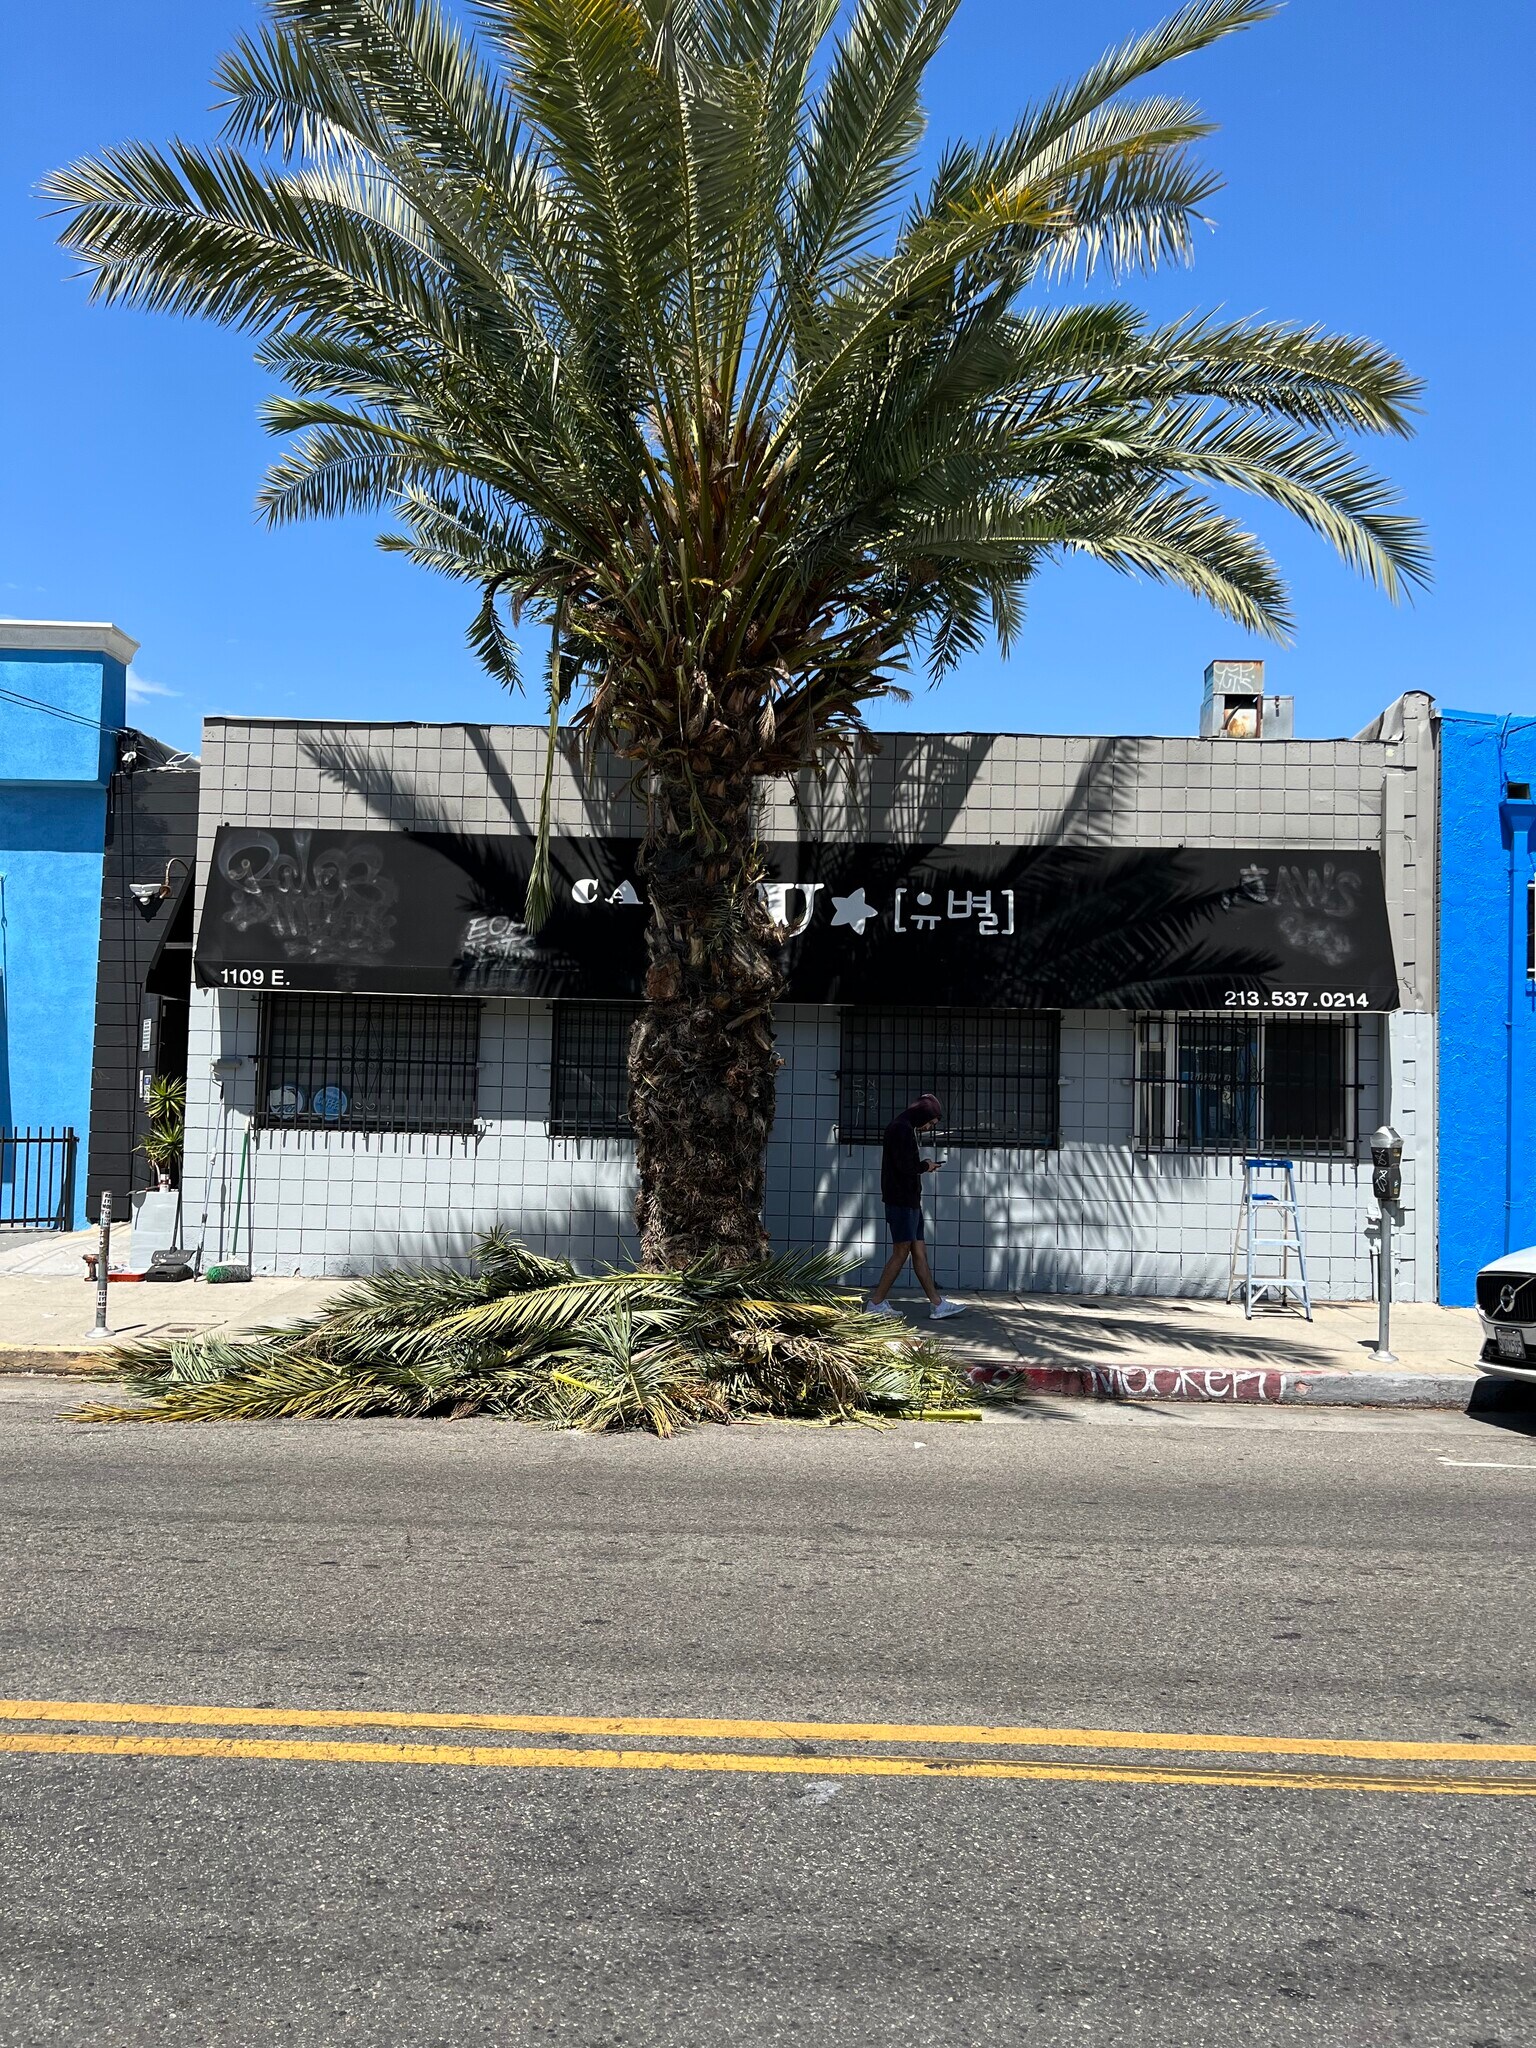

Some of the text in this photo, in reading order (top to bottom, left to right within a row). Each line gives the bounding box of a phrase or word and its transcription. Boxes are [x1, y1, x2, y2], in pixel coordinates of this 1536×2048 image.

[571, 878, 644, 905] CA
[220, 968, 291, 986] 1109 E.
[1224, 990, 1369, 1008] 213.537.0214
